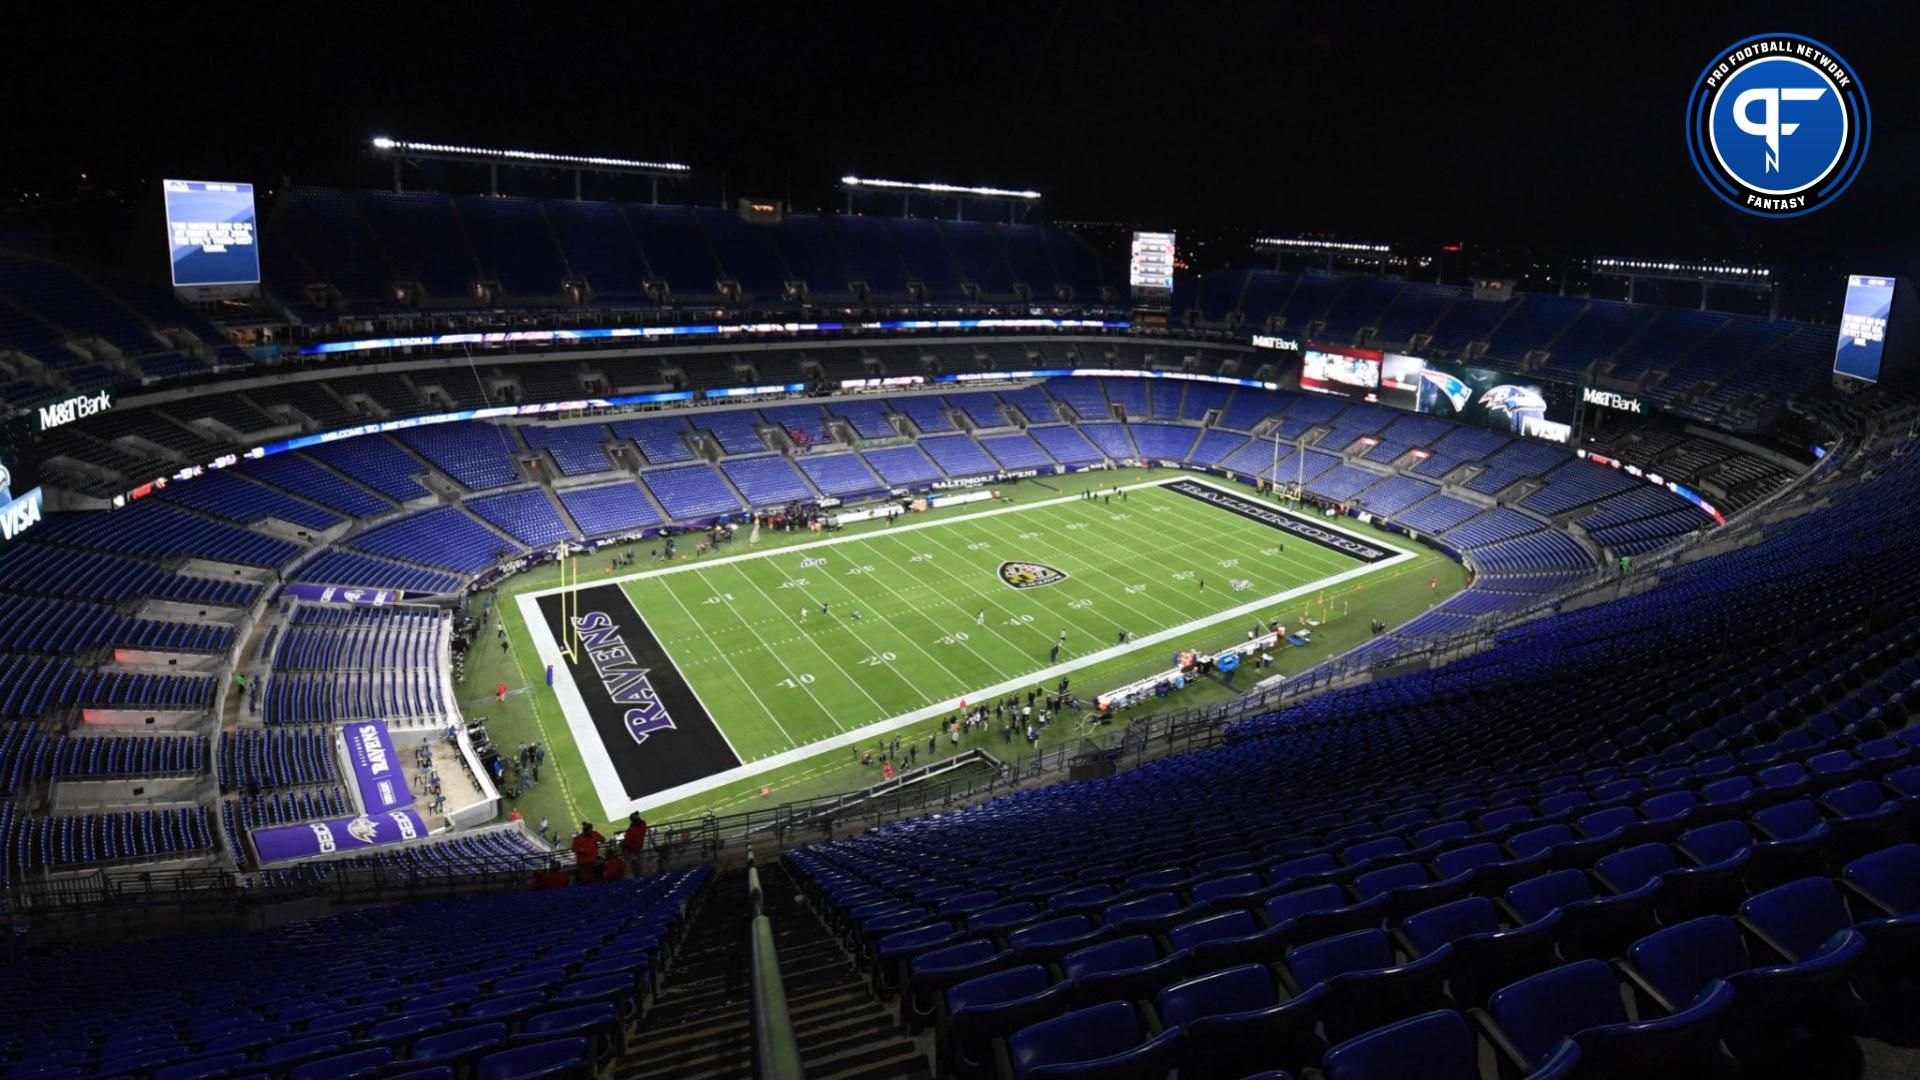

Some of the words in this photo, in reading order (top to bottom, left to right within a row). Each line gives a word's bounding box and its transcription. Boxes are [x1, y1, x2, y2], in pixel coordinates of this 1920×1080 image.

[1276, 338, 1298, 351] Bank
[38, 398, 78, 431] M&T
[77, 389, 112, 419] Bank
[1612, 393, 1641, 413] Bank
[0, 495, 41, 540] VISA
[1170, 481, 1386, 559] BALTIMORE
[570, 611, 677, 745] RAVENS
[359, 724, 391, 776] RAVENS
